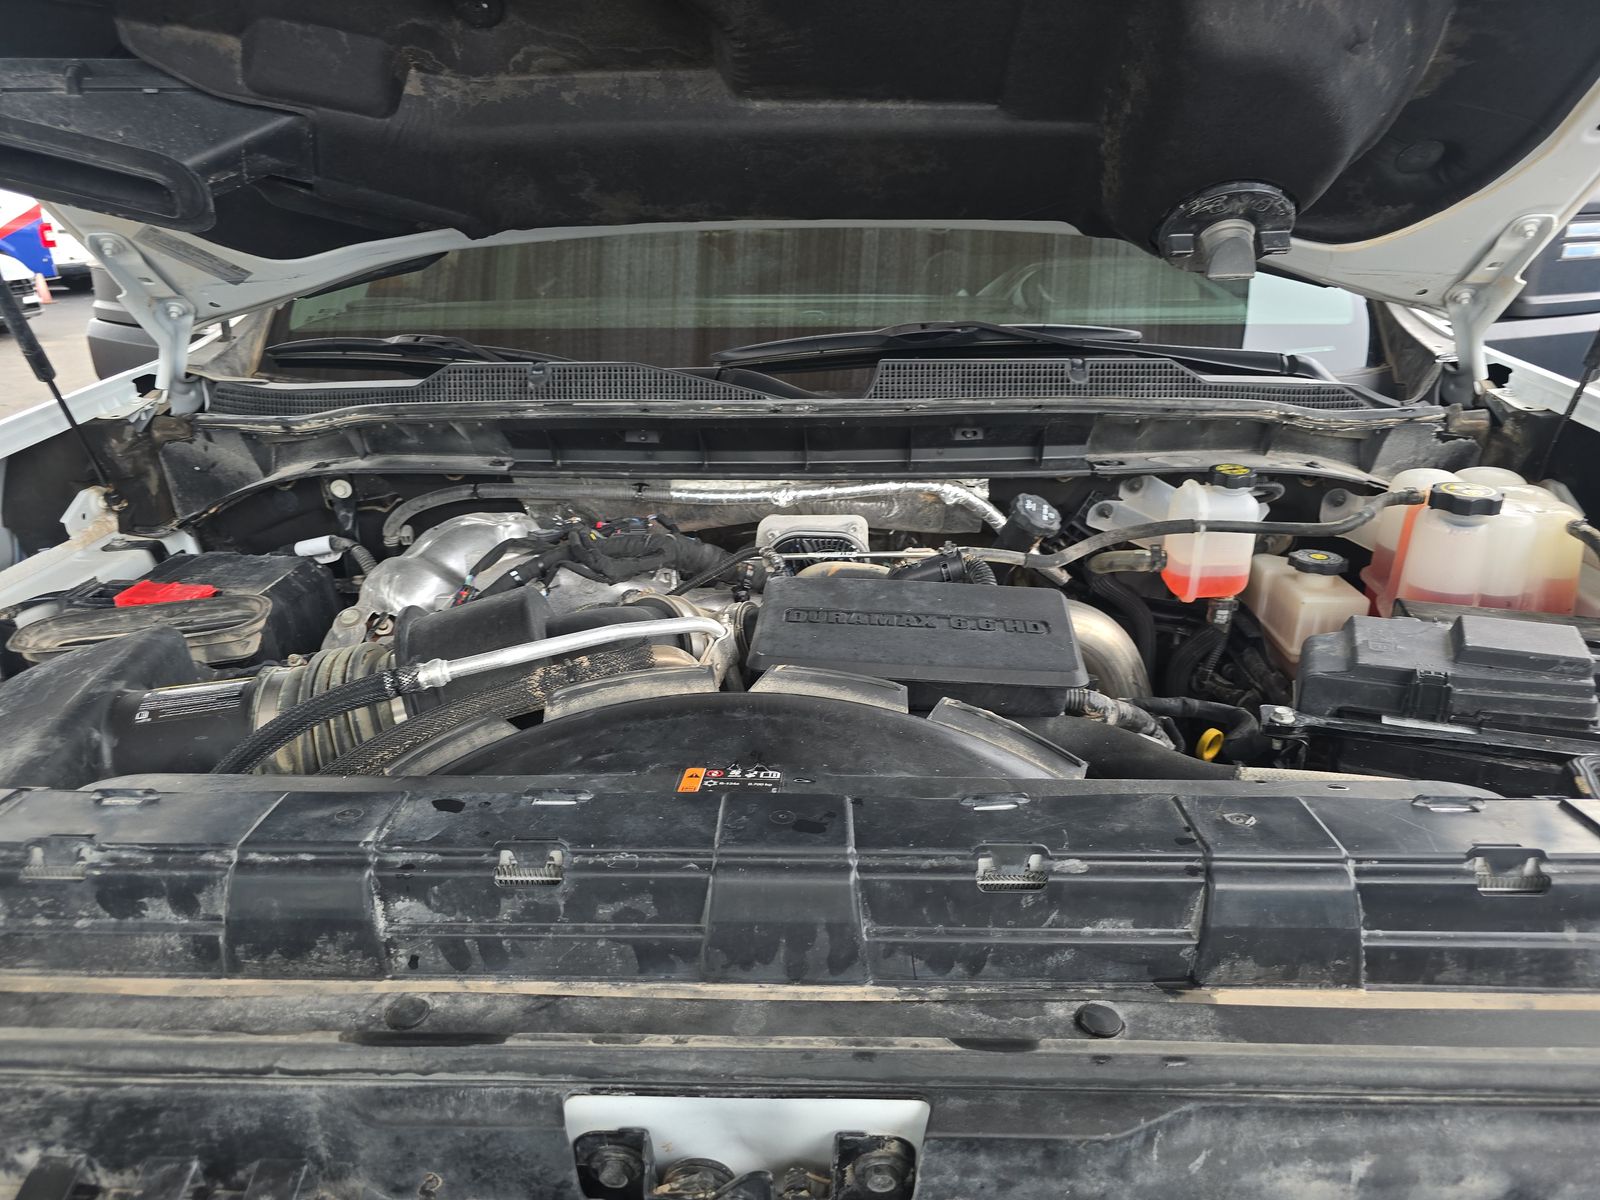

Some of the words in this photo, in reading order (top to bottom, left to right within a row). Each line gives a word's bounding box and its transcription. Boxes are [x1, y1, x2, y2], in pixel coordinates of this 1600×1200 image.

[787, 609, 937, 629] DURAMAX
[950, 616, 998, 632] 6.6
[1003, 619, 1048, 635] HD
